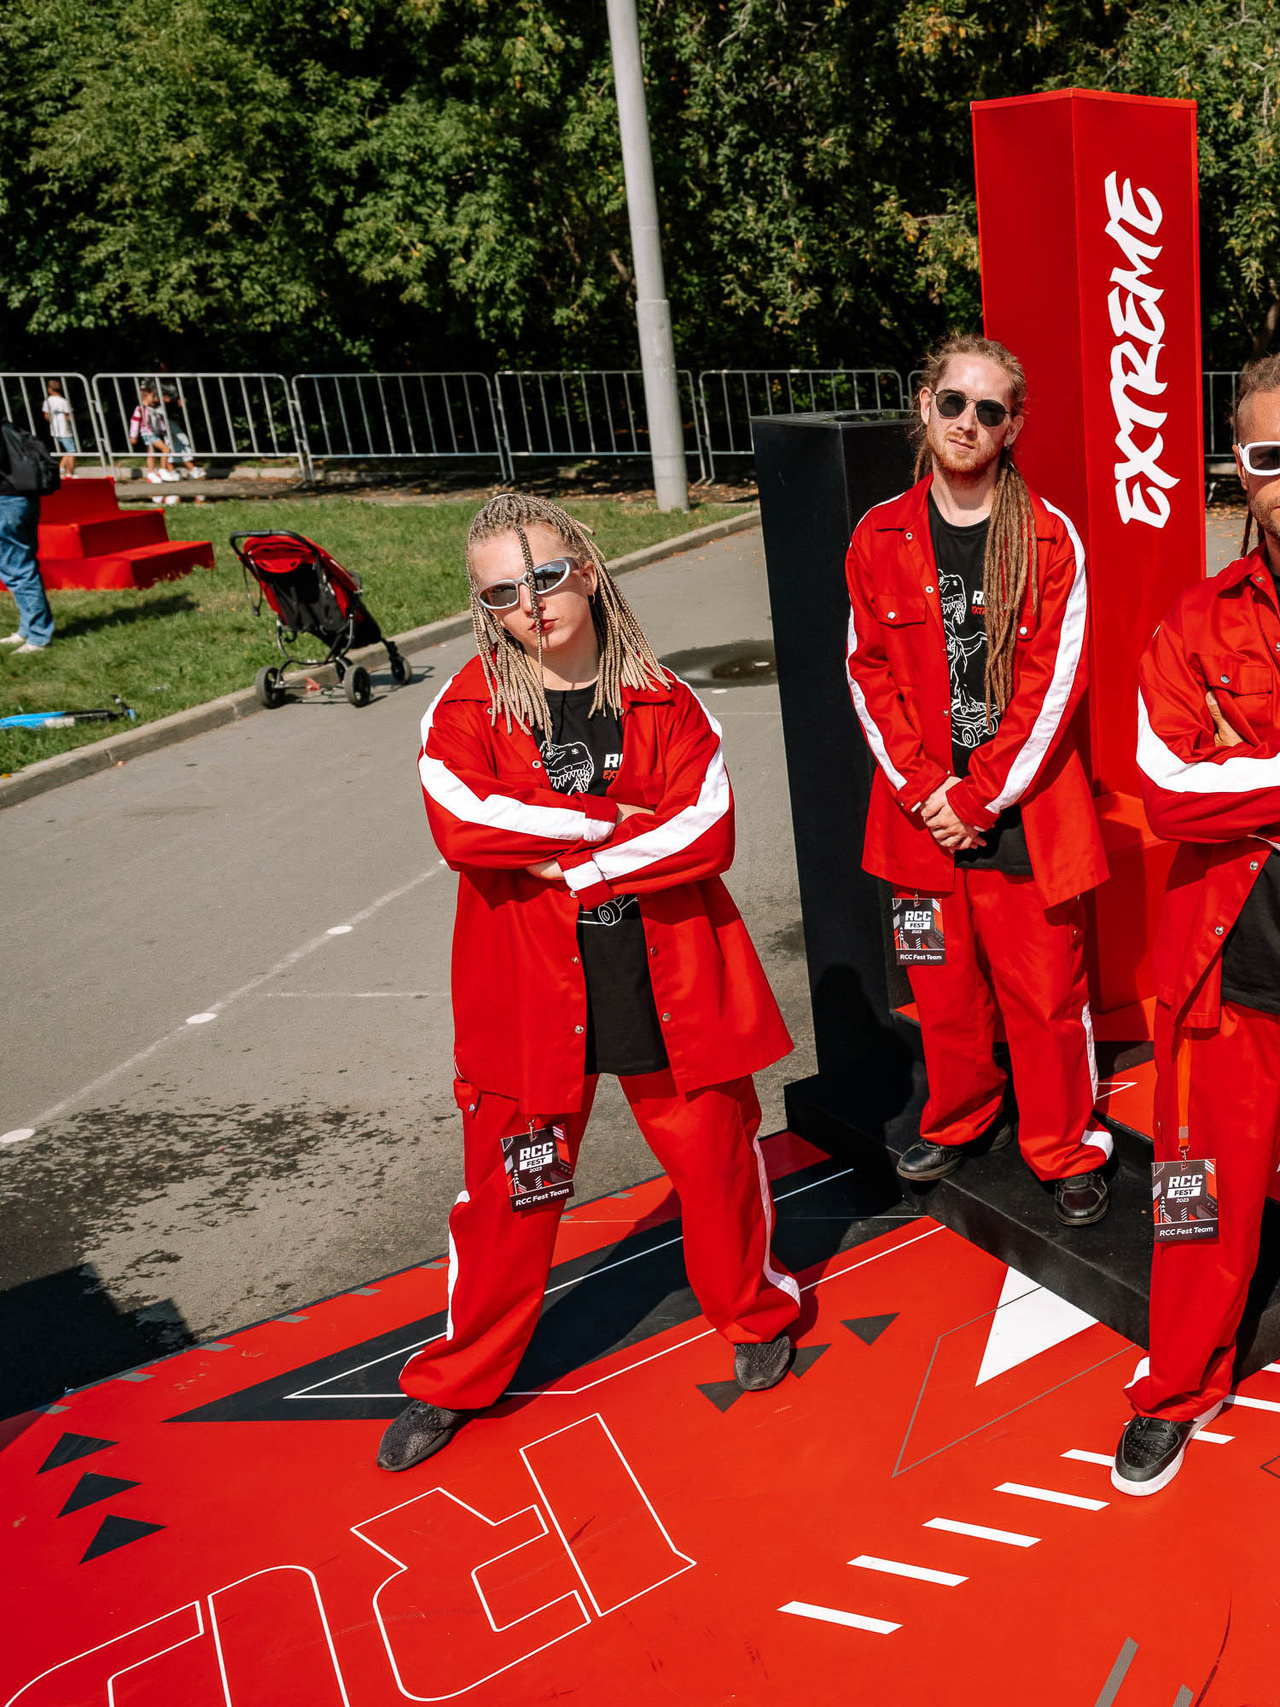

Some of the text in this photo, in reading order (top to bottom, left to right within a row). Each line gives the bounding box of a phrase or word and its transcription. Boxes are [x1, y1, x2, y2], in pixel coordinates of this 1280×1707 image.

[1104, 170, 1181, 529] EXTREME
[905, 911, 932, 921] RCC
[519, 1141, 554, 1161] RCC
[526, 1157, 546, 1167] FEST
[1168, 1174, 1203, 1188] RCC
[515, 1188, 569, 1206] RCC Fest Team
[1160, 1229, 1176, 1237] RCC
[1176, 1227, 1193, 1235] Fest
